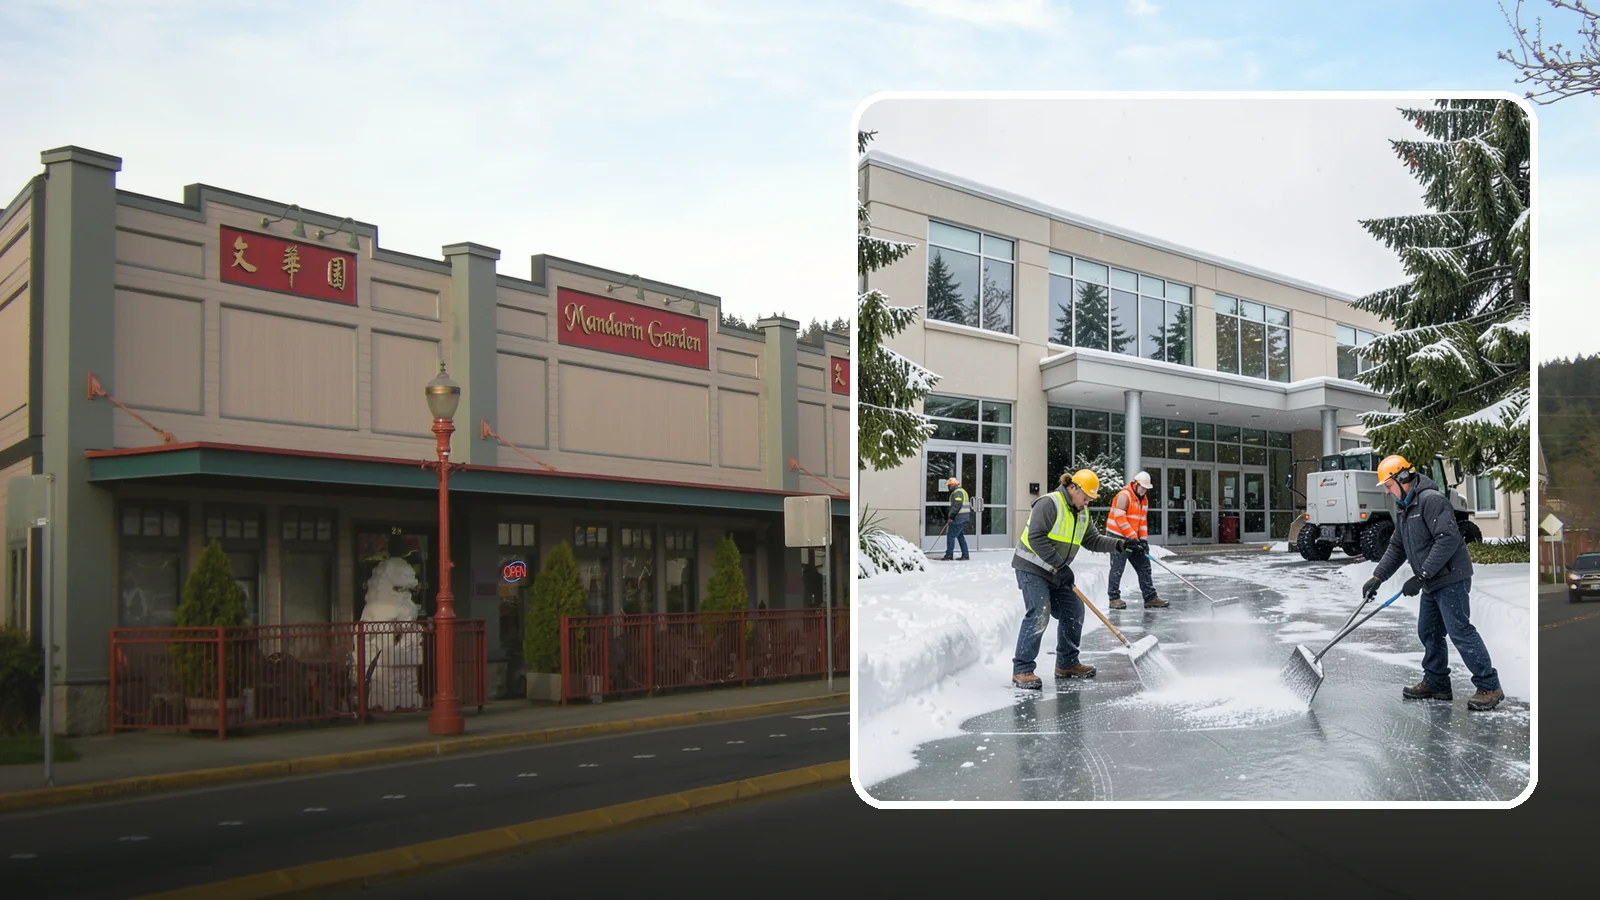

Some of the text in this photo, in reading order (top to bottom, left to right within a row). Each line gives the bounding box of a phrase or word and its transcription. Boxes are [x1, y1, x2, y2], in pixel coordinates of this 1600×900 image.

[231, 236, 346, 290] 文華園
[564, 302, 701, 352] Mandarin Garden
[503, 565, 526, 578] OPEN
